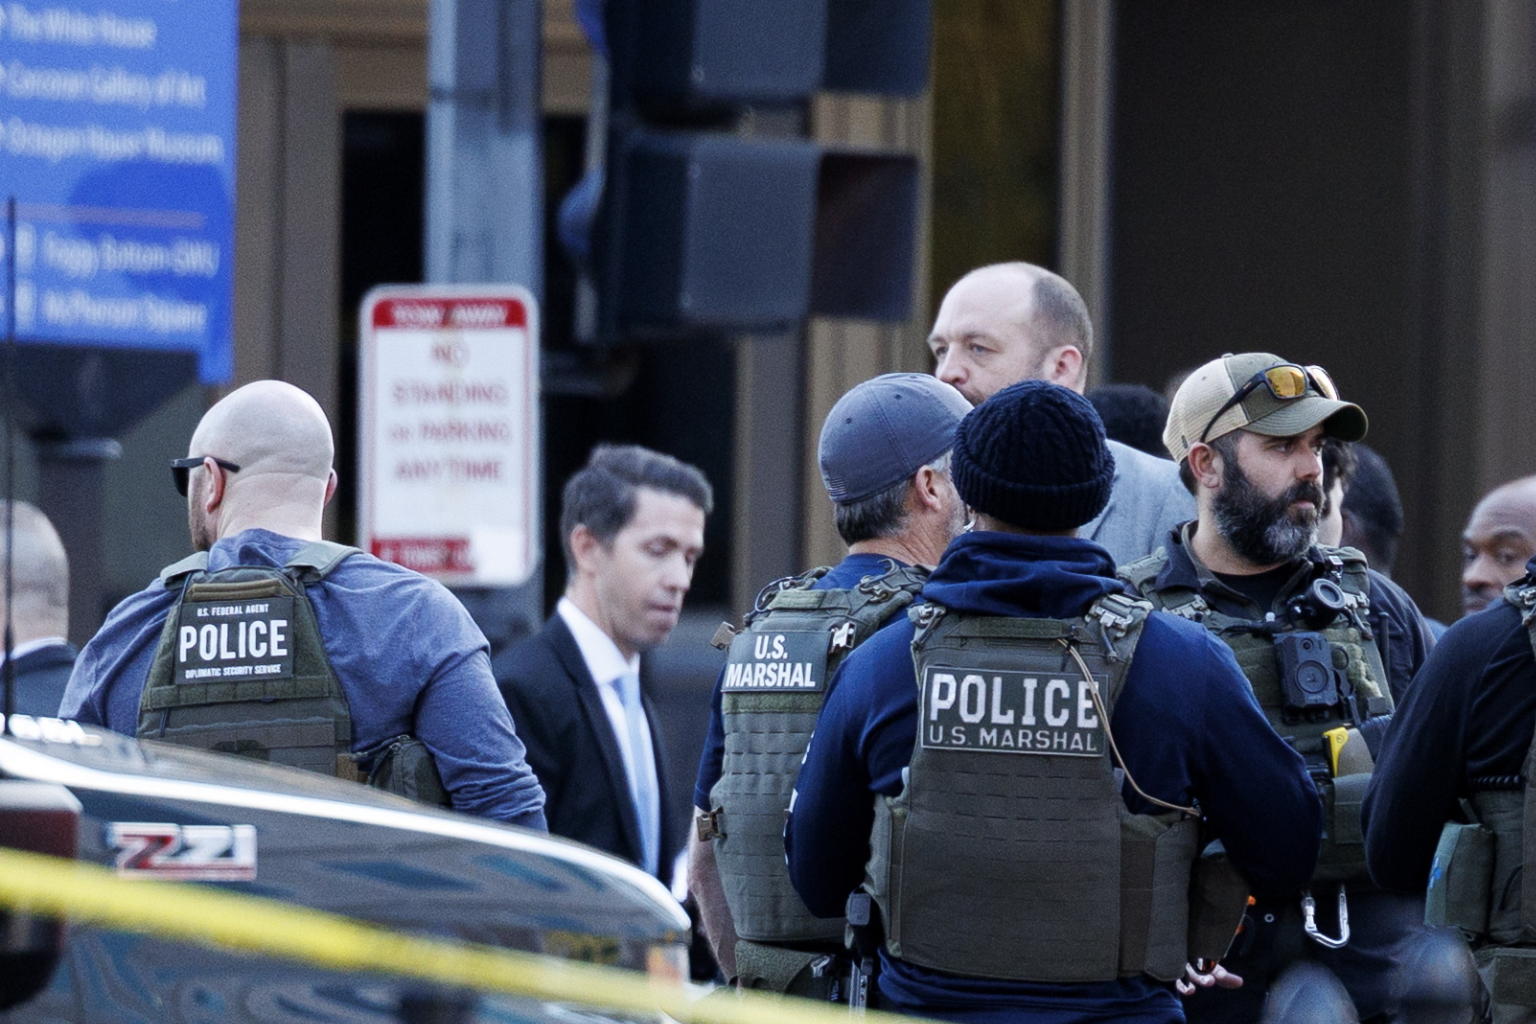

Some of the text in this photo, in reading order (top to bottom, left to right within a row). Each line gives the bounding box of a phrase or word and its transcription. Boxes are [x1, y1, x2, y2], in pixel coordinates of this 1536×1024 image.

[197, 603, 269, 617] U.S. FEDERAL AGENT
[179, 619, 288, 662] POLICE
[755, 634, 787, 660] U.S.
[185, 664, 281, 679] DIPLOMATIC SECURITY SERVICE
[725, 663, 816, 688] MARSHAL
[930, 673, 1100, 729] POLICE
[930, 725, 1097, 751] U.S. MARSHAL
